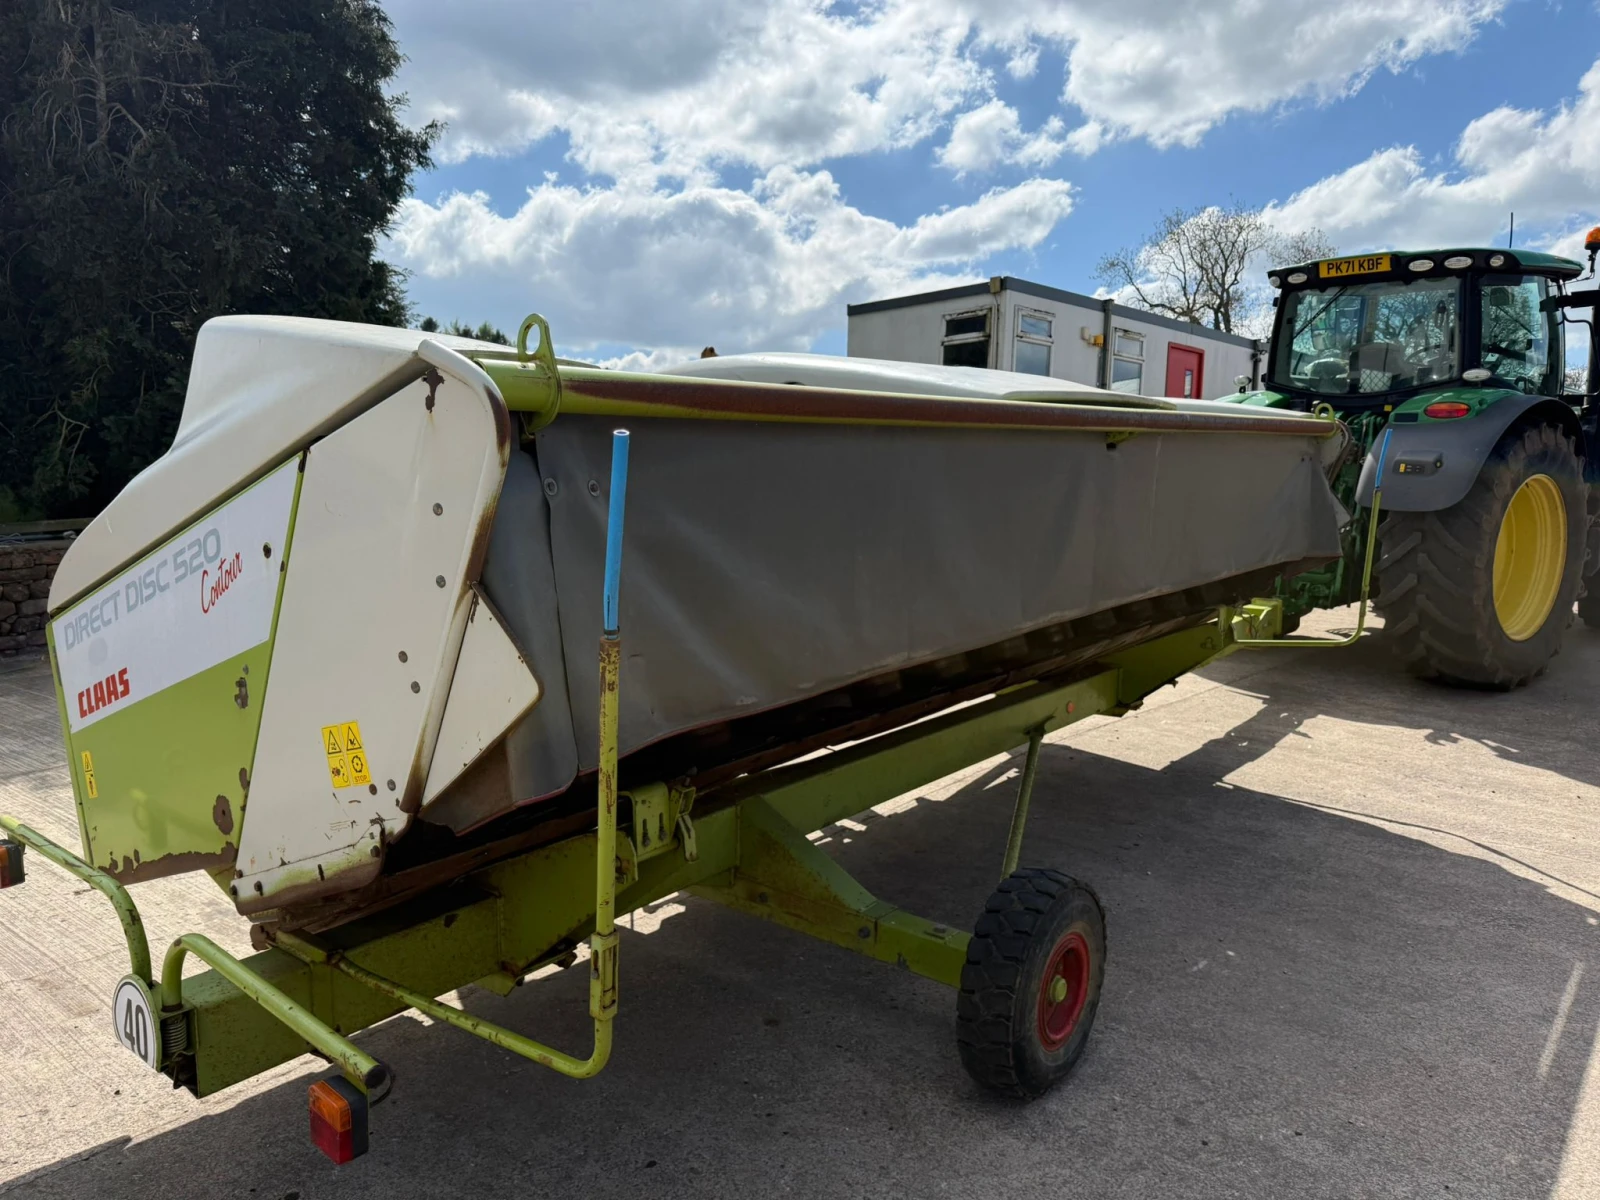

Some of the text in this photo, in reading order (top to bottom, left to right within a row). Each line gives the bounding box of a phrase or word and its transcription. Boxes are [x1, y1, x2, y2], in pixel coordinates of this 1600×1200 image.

[1327, 260, 1355, 275] PK71
[64, 528, 221, 651] DIRECT DISC 520
[201, 552, 243, 614] Contour
[78, 667, 130, 719] CLAAS
[354, 775, 367, 783] STOP
[124, 998, 148, 1063] 40
